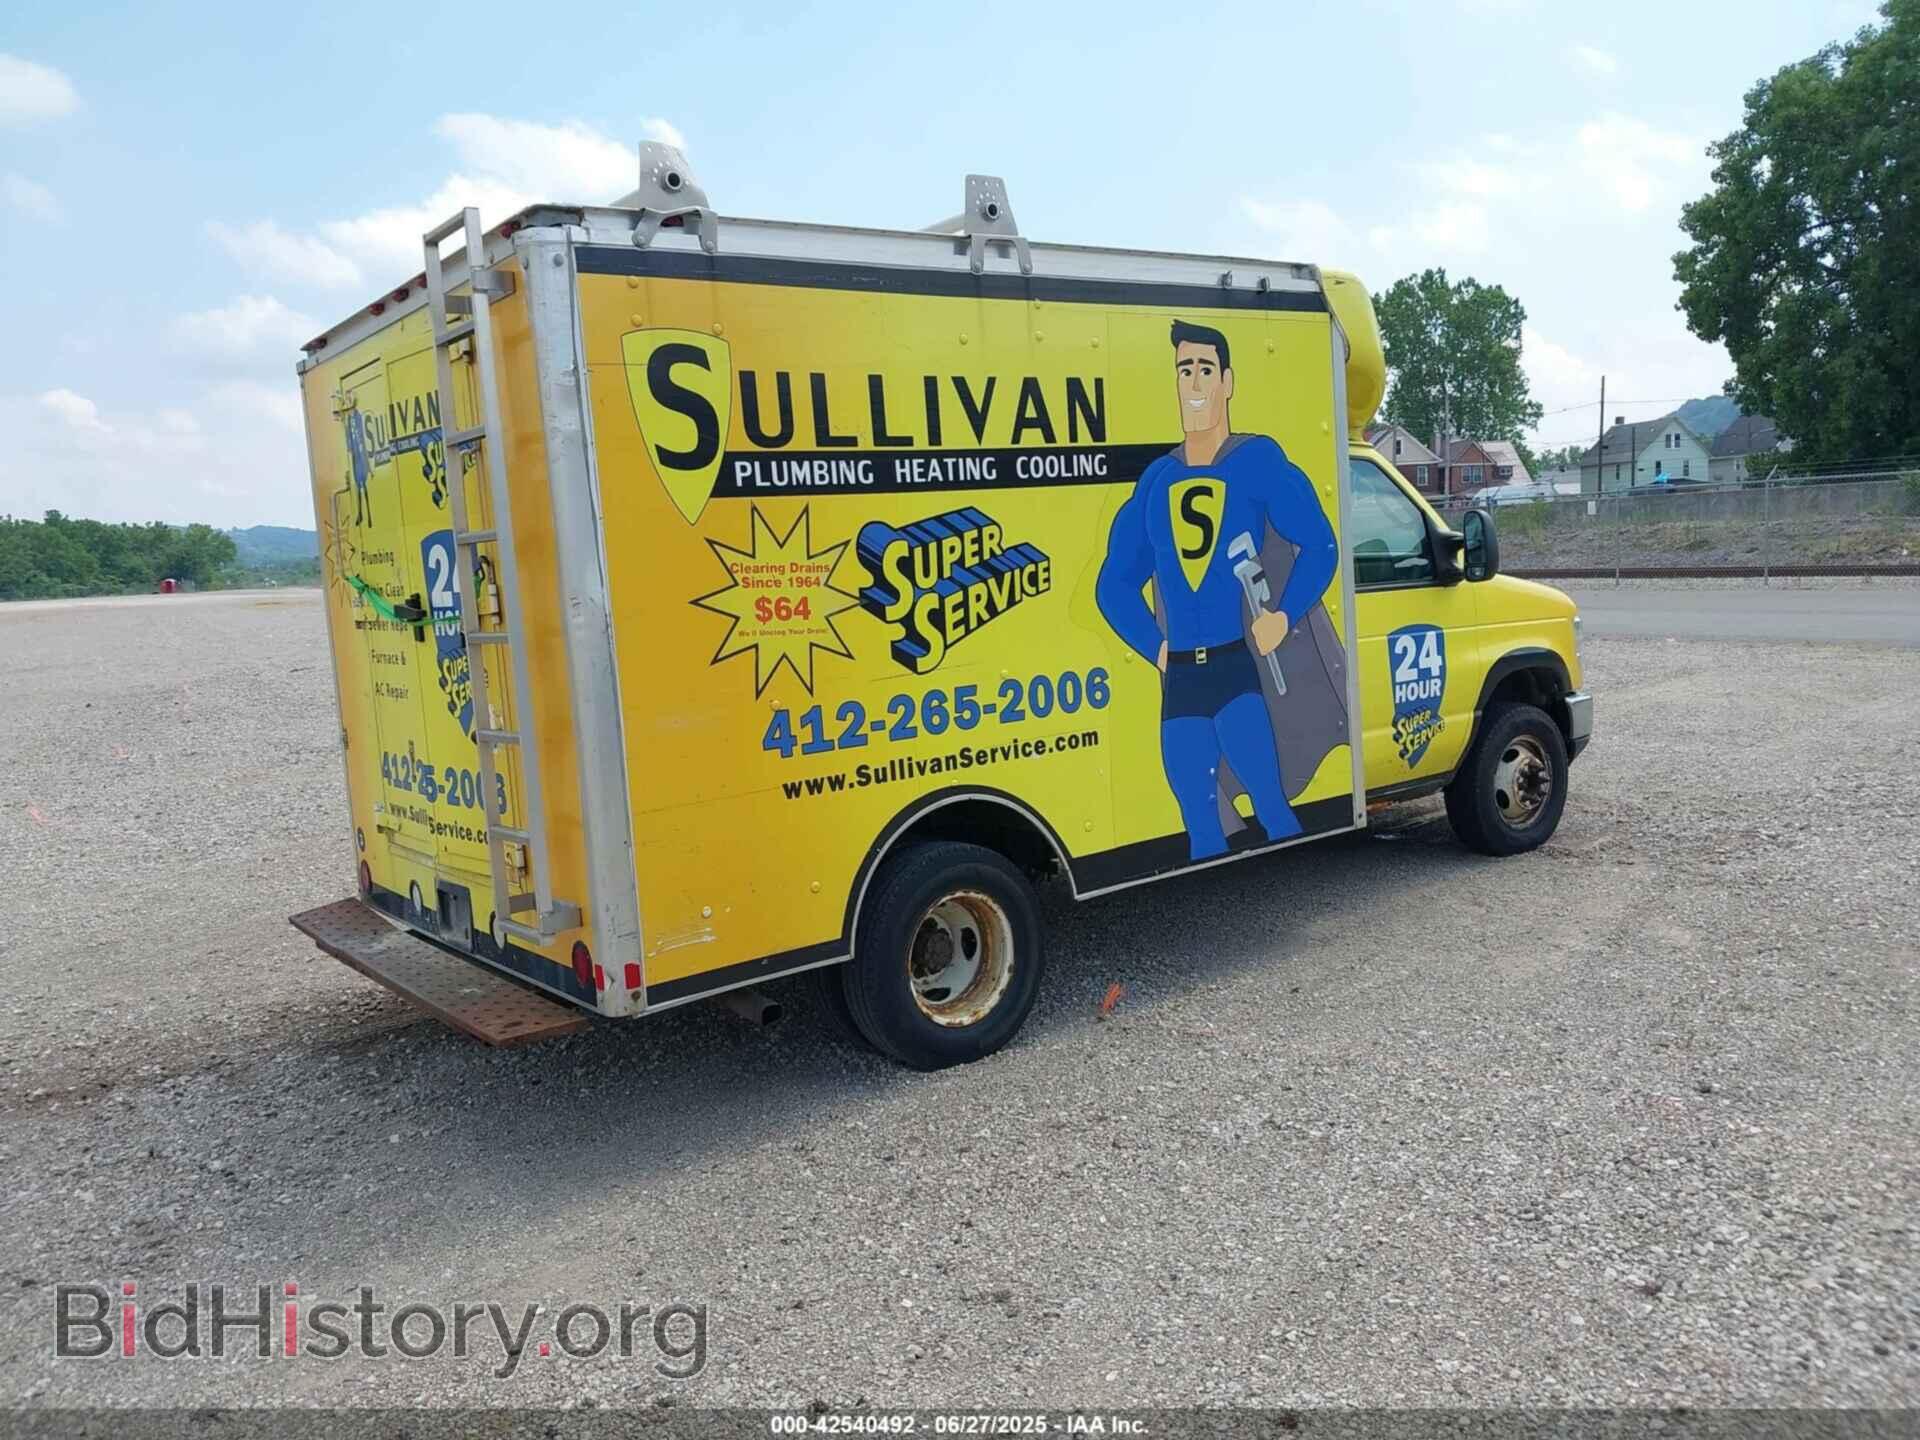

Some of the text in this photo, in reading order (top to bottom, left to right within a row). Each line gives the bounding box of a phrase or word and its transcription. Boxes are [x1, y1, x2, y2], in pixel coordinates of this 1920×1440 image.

[646, 342, 1107, 471] SULLIVAN
[735, 453, 1108, 488] PLUMBING HEATING COOLING
[1181, 486, 1214, 560] S
[361, 551, 394, 567] Plumbing
[730, 562, 830, 576] Clearing Drains
[882, 523, 1004, 623] SUPER
[742, 576, 821, 589] Since 1964
[755, 594, 811, 625] $64
[914, 559, 1050, 675] SERVICE
[1395, 630, 1443, 683] 24
[762, 667, 1111, 759] 412-265-2006
[1396, 678, 1442, 704] HOUR
[1397, 709, 1432, 744] SUPER
[783, 729, 1099, 800] www.SullivanService.com
